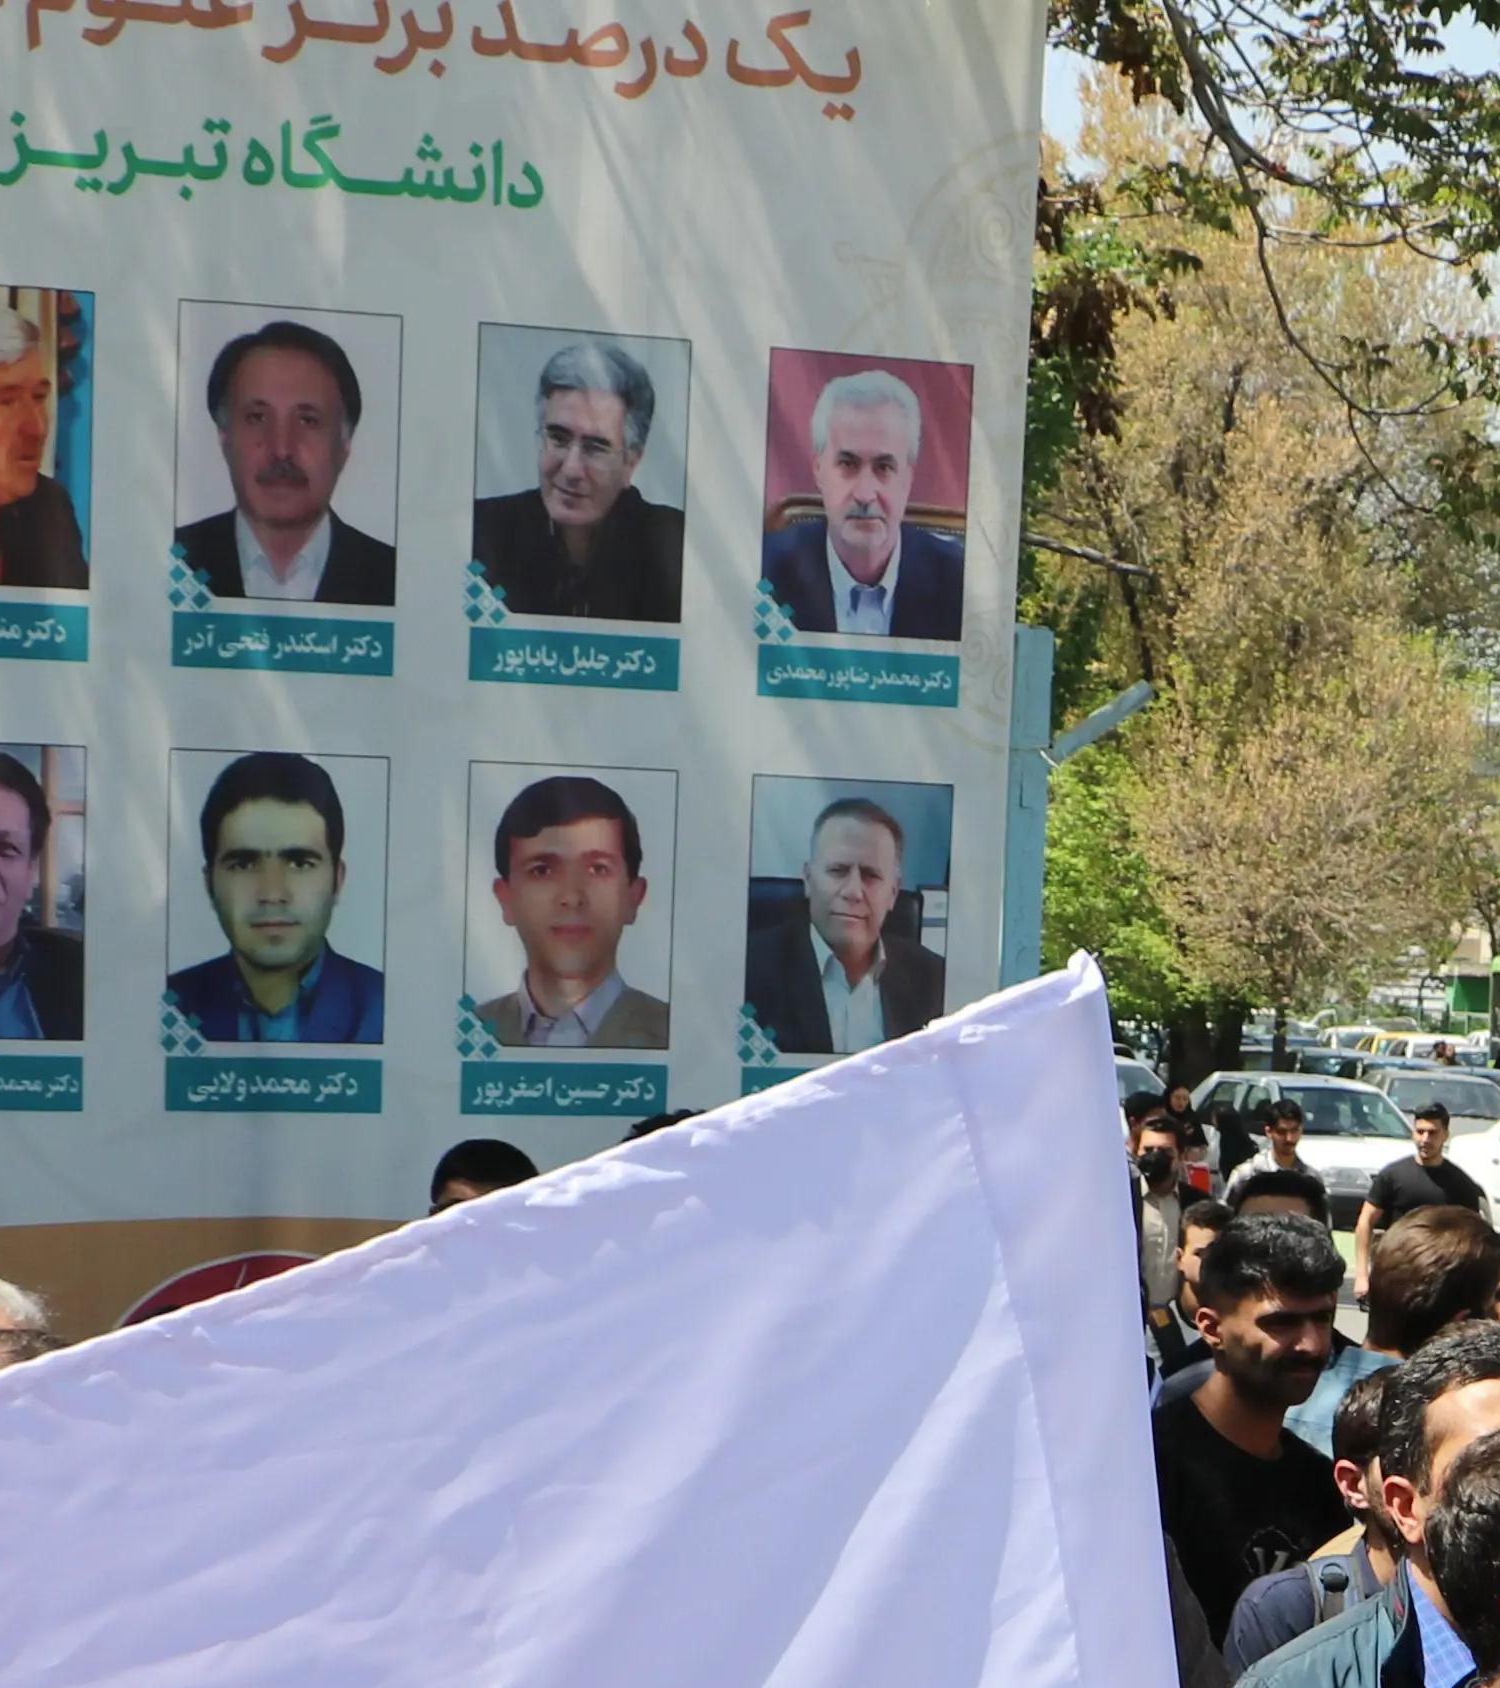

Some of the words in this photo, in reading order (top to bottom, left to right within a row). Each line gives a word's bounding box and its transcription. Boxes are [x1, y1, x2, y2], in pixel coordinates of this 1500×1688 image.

[471, 0, 709, 98] درصد
[726, 9, 862, 121] یک
[242, 114, 545, 208] دانشگاه
[23, 616, 68, 648] دکتر
[217, 627, 271, 658] فتحی
[272, 631, 339, 660] اسکندر
[341, 633, 383, 663] دکتر
[558, 644, 611, 677] جلیل
[611, 648, 657, 679] دکتر
[921, 669, 953, 693] دکتر
[44, 1073, 80, 1099] دکتر
[186, 1070, 249, 1103] ولایی
[249, 1074, 312, 1096] محمد
[313, 1071, 359, 1103] دکتر
[553, 1081, 611, 1107] حسین
[611, 1076, 657, 1107] دکتر
